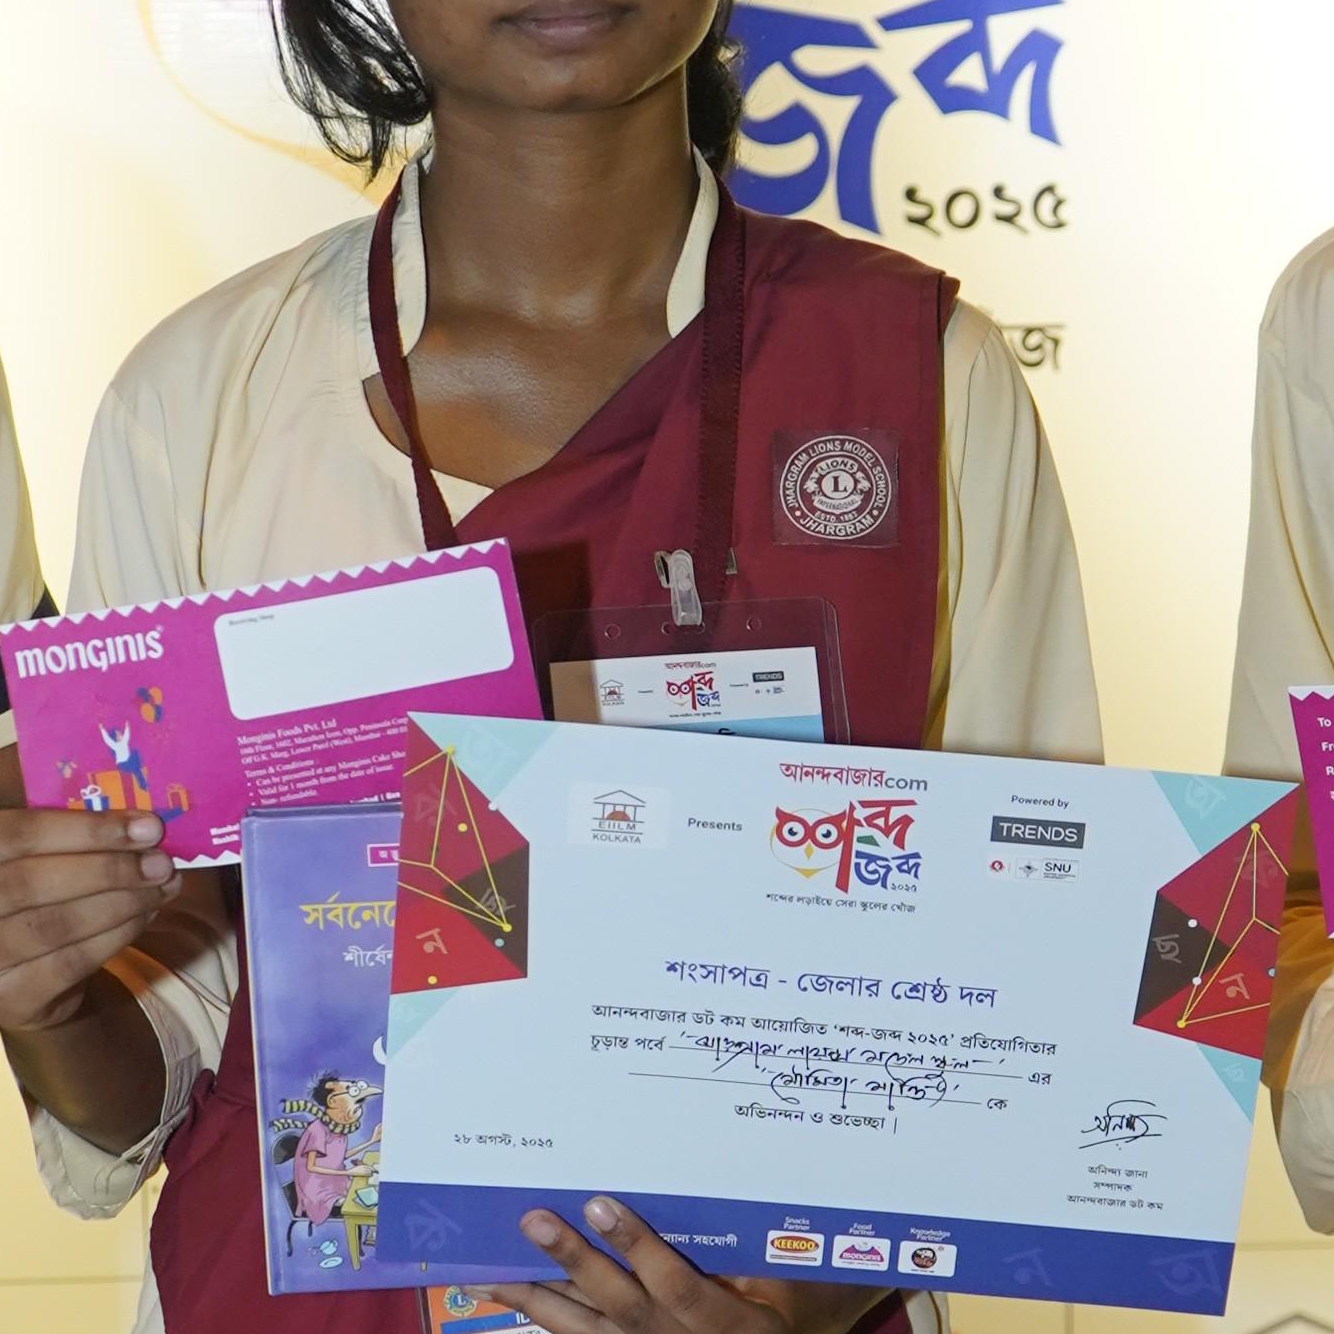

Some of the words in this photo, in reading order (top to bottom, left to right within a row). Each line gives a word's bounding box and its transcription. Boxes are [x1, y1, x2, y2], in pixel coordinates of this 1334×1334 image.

[905, 186, 1071, 236] ২০২৫
[784, 453, 810, 507] JHARGRAM
[810, 440, 841, 457] LIONS
[844, 441, 876, 467] MODEL
[873, 466, 885, 512] SCHOOL
[799, 515, 875, 536] JHARGRAM
[321, 719, 337, 730] Ltd
[1317, 717, 1331, 727] To
[1011, 794, 1054, 809] Powered
[1057, 797, 1069, 810] by
[598, 821, 636, 831] EIILM
[688, 817, 743, 832] Presents
[999, 821, 1079, 843] TRENDS
[592, 833, 641, 844] KOLKATA
[1043, 861, 1072, 874] SNU
[665, 960, 770, 989] শংসাপত্র
[798, 972, 883, 998] জেলার
[891, 977, 952, 1003] শ্রেষ্ঠ
[959, 986, 998, 1008] দল
[591, 1005, 686, 1024] আনন্দবাজার
[692, 1010, 715, 1025] ডট
[720, 1015, 746, 1028] কম
[751, 1017, 827, 1035] আয়োজিত
[960, 1032, 1058, 1055] প্রতিযোগিতার
[590, 1035, 629, 1051] চূড়ান্ত
[635, 1036, 667, 1051] পর্বে
[1028, 1073, 1052, 1085] এর
[987, 1098, 1009, 1110] কে
[735, 1102, 804, 1122] অভিনন্দন
[810, 1113, 824, 1124] ও
[829, 1114, 885, 1129] শুভেচ্ছা
[774, 1238, 815, 1251] KEEKOO
